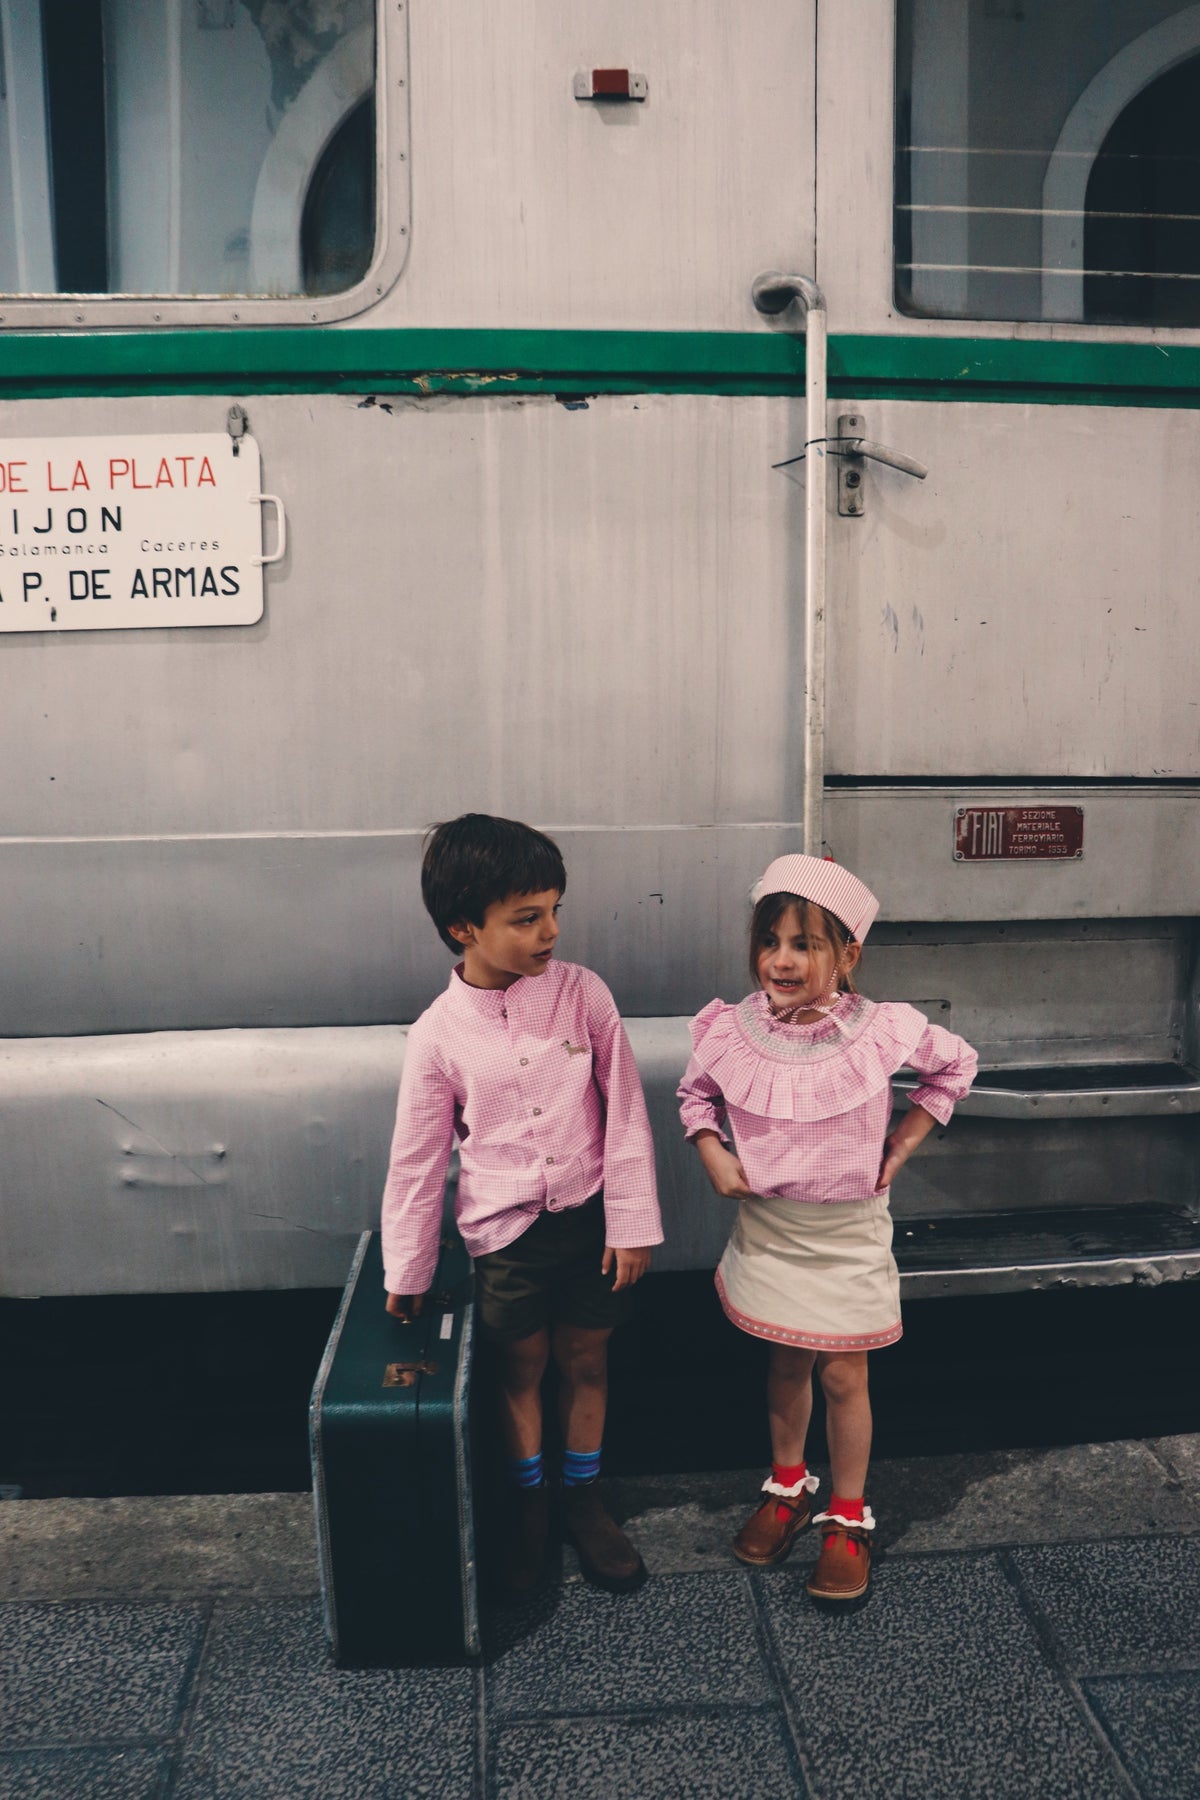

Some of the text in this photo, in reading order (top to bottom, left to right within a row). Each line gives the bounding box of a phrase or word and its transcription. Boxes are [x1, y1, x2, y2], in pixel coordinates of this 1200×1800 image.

[48, 460, 90, 492] LA
[109, 456, 216, 490] PLATA
[140, 539, 220, 553] Caceres
[22, 572, 50, 602] P.
[69, 569, 111, 600] DE
[130, 565, 240, 599] ARMAS
[971, 811, 1006, 855] FIAT
[1012, 834, 1065, 843] FERROVIARIO
[1016, 822, 1061, 831] MATERIALE
